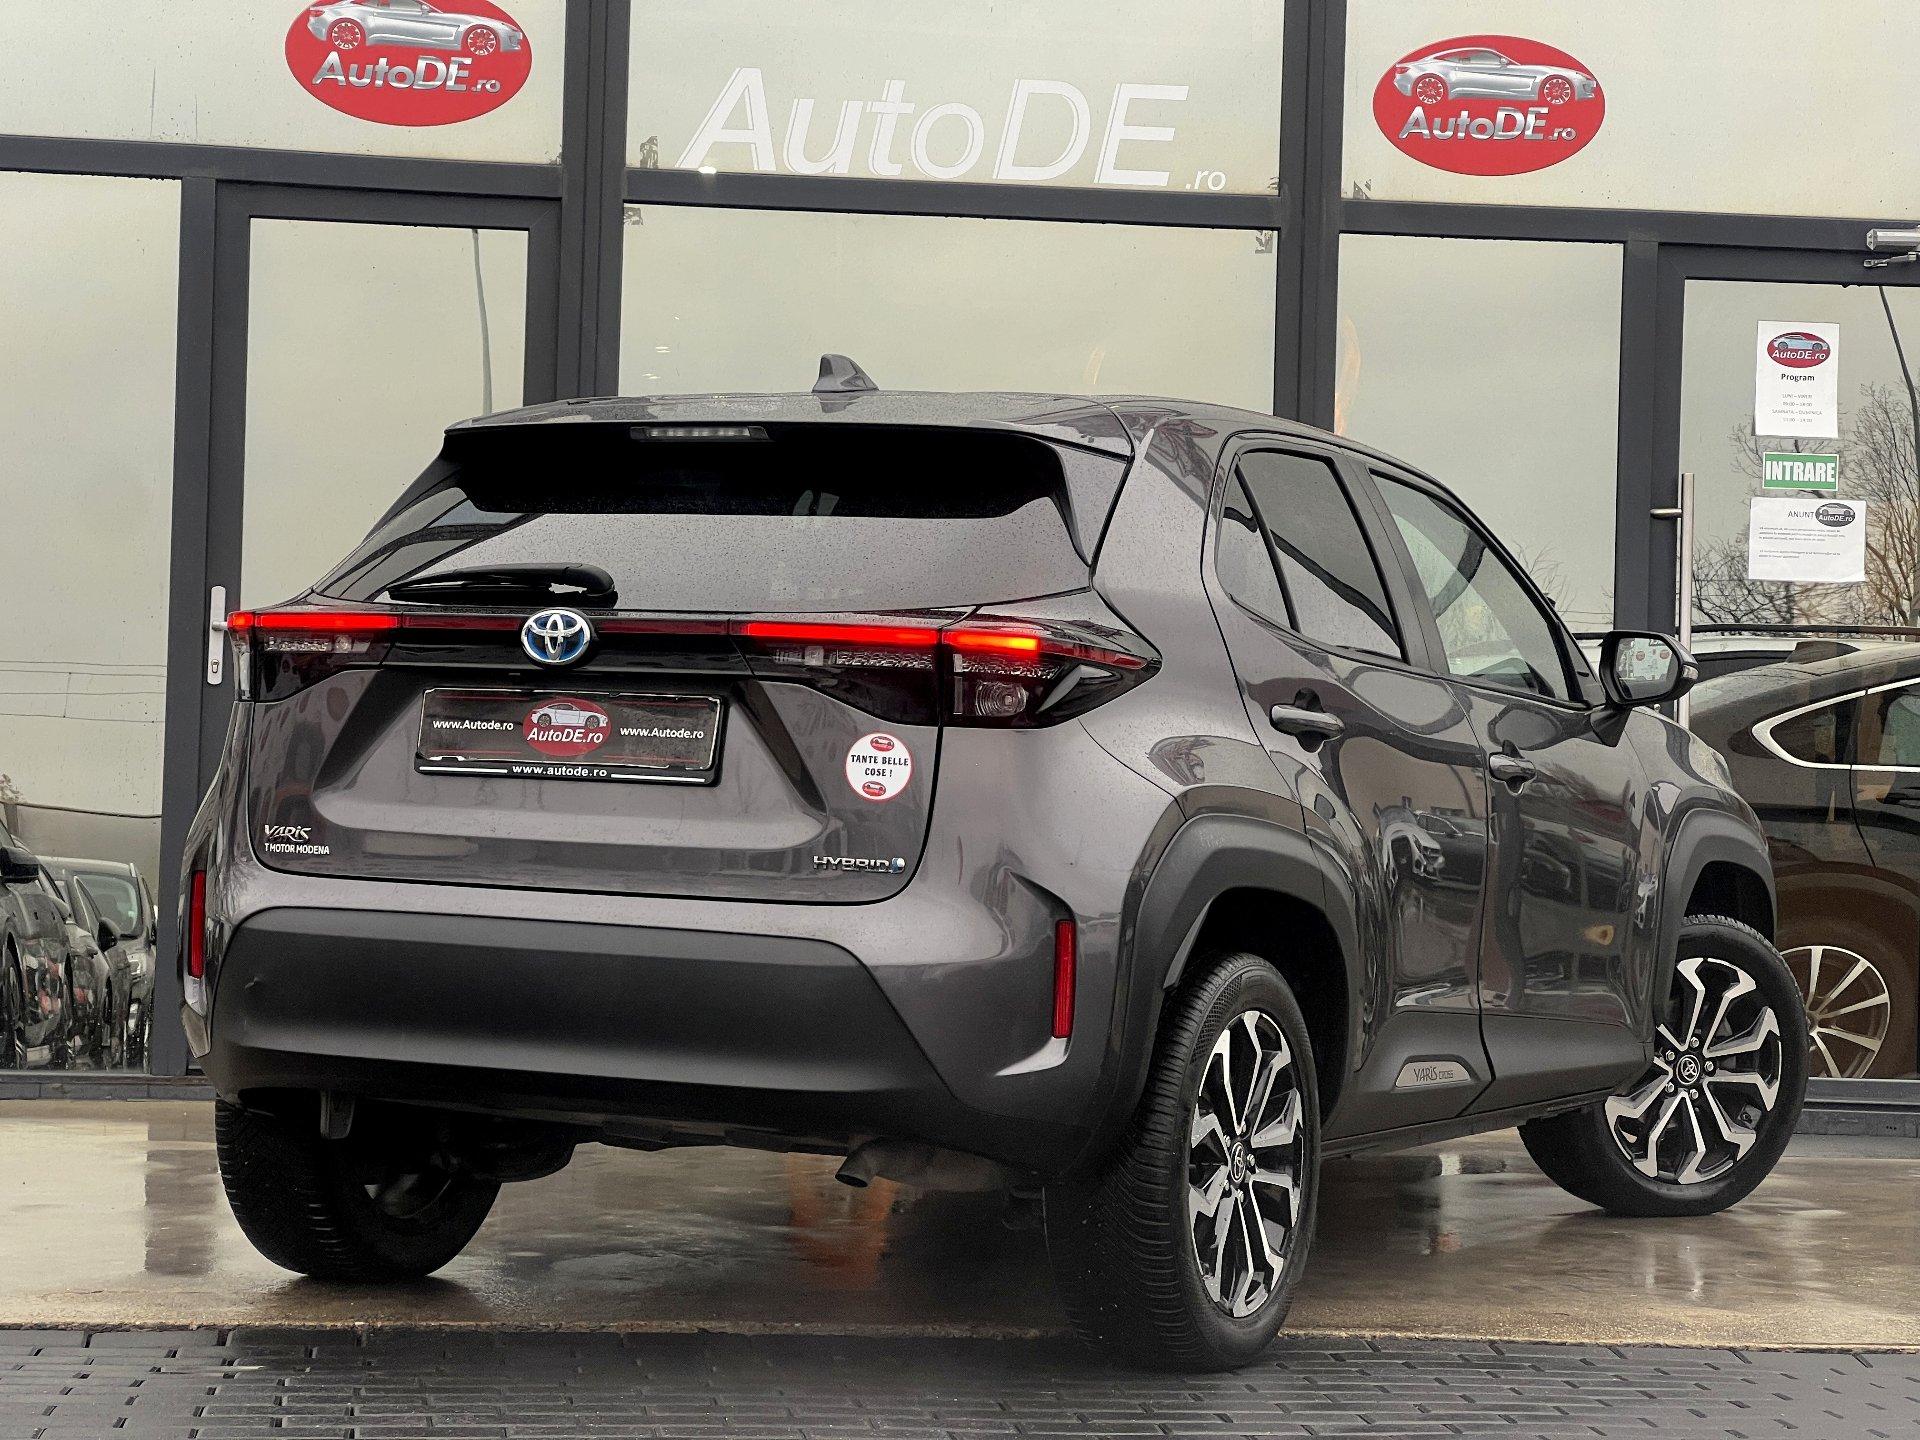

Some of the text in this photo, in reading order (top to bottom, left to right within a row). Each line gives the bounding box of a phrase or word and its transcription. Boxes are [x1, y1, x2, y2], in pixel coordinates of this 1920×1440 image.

[1772, 350, 1826, 360] AutoDE.ro
[1781, 373, 1815, 382] Program
[1765, 461, 1836, 482] INTRARE
[432, 719, 514, 731] www.Autode.ro
[526, 727, 603, 744] AutoDE.ro
[620, 726, 704, 739] www.Autode.ro
[851, 754, 909, 766] TANTE BELLE
[512, 764, 607, 777] www.autode.ro
[865, 768, 886, 776] COSE
[296, 845, 330, 855] MODENA
